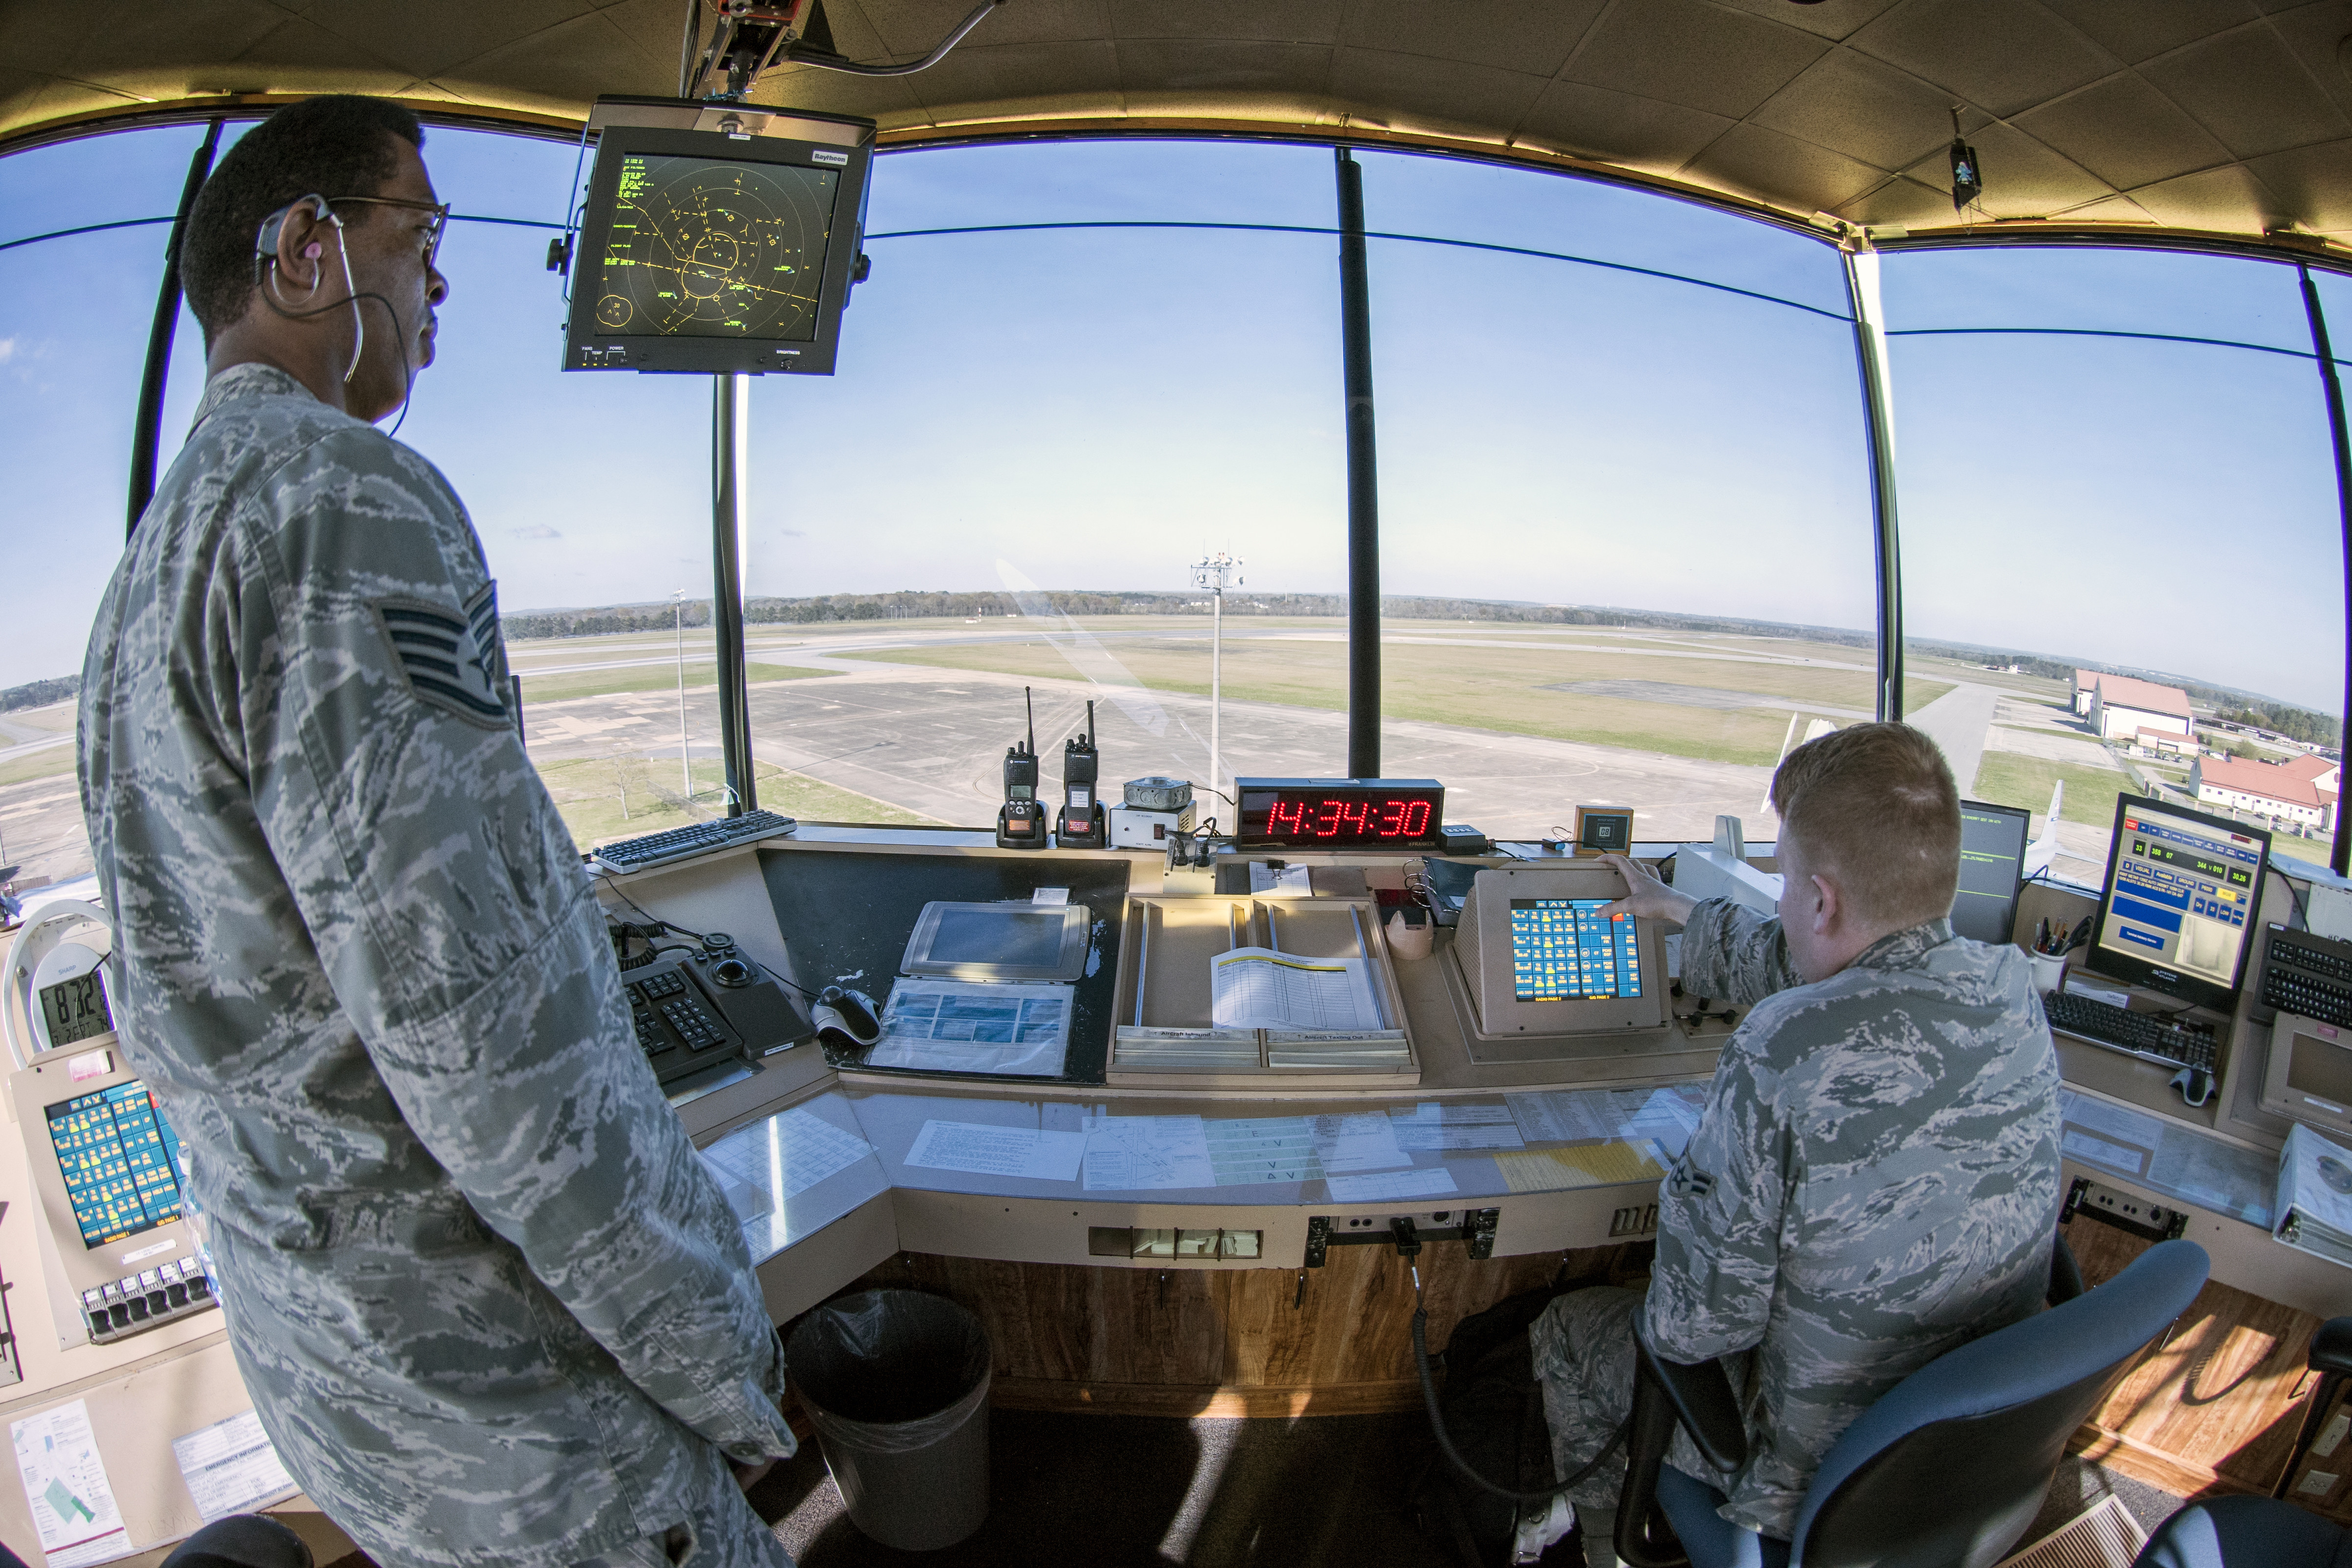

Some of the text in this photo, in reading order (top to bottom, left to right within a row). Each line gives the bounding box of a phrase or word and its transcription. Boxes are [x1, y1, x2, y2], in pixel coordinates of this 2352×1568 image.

[815, 153, 845, 163] Raytheon
[1266, 800, 1432, 836] 14:34:30
[2151, 848, 2161, 856] 358
[2197, 861, 2207, 869] 344
[2213, 865, 2223, 874] 010
[2135, 865, 2150, 874] VISUAL
[2156, 872, 2173, 881] Available
[2179, 877, 2195, 886] GROUND
[2232, 873, 2247, 882] 30.26
[58, 964, 77, 976] SHARP
[2159, 970, 2178, 979] SYSTEMS
[164, 1215, 175, 1224] PAGE
[104, 1234, 117, 1244] RADIO
[116, 1231, 127, 1240] PAGE
[187, 1472, 210, 1486] AIRCRAFT
[246, 1449, 267, 1461] NUMBER
[205, 1454, 239, 1471] EMERGENCY
[192, 1486, 209, 1496] NATURE
[215, 1472, 244, 1488] EMERGENCY
[196, 1495, 217, 1507] LANDING
